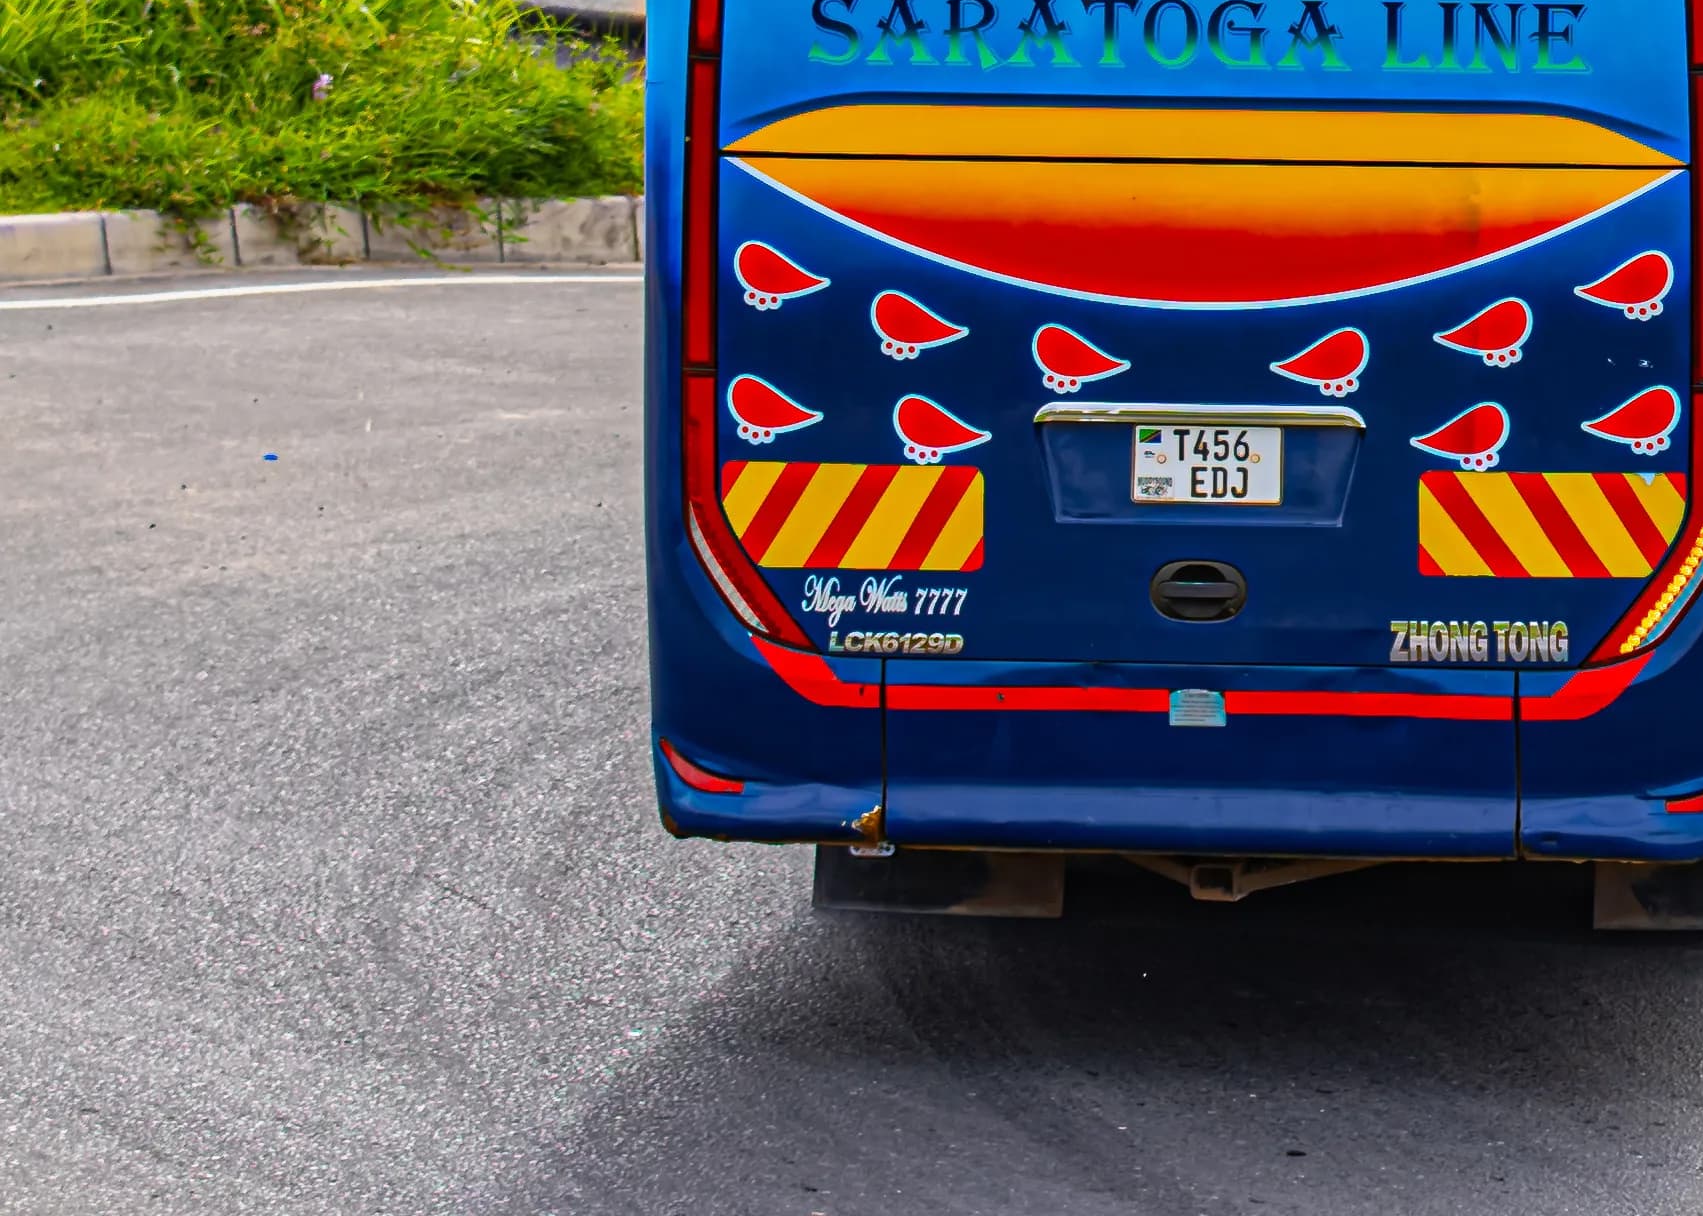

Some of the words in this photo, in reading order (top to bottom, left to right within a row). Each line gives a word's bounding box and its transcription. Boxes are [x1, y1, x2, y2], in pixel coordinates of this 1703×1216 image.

[1380, 0, 1593, 74] LINE
[1173, 428, 1250, 462] T456
[1190, 466, 1249, 499] EDJ
[801, 574, 857, 628] Mega
[859, 575, 908, 615] Watts
[914, 587, 968, 616] 7777
[828, 630, 964, 655] LCK6129D
[1389, 620, 1489, 663] ZHONG
[1492, 620, 1569, 663] TONG
